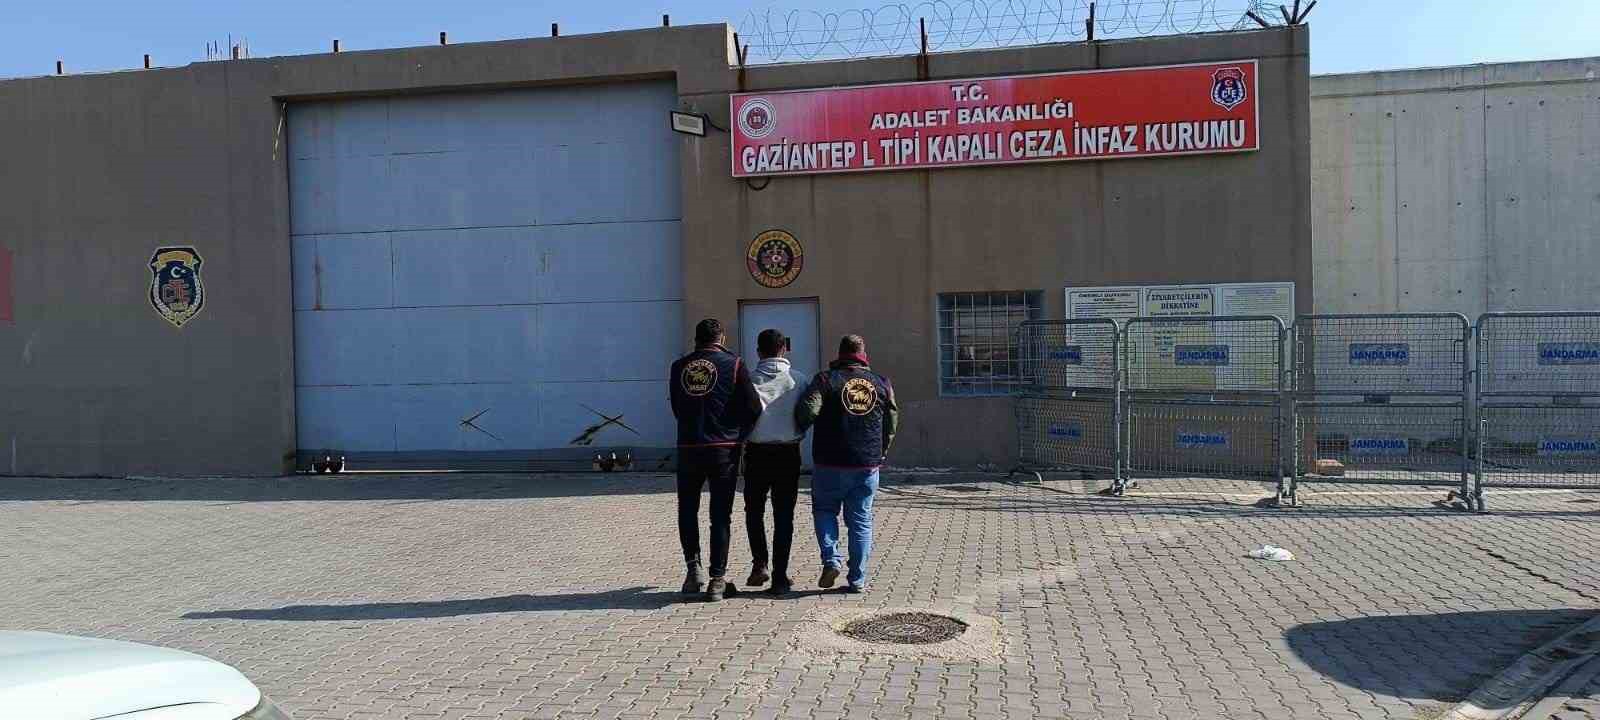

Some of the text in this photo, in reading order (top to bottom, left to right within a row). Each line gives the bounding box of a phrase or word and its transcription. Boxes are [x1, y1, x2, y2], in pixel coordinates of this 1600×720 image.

[951, 85, 988, 102] T.C.
[871, 98, 1074, 131] ADALET BAKANLIĞI
[742, 119, 1246, 173] GAZİANTEP L TİPİ KAPALI CEZA İNFAZ KURUMU
[1351, 350, 1407, 361] JANDARMA
[1541, 348, 1599, 360] JANDARMA
[1176, 432, 1226, 444] JANDARMA
[1350, 439, 1406, 450] JANDARMA
[1540, 441, 1598, 452] JANDARMA
